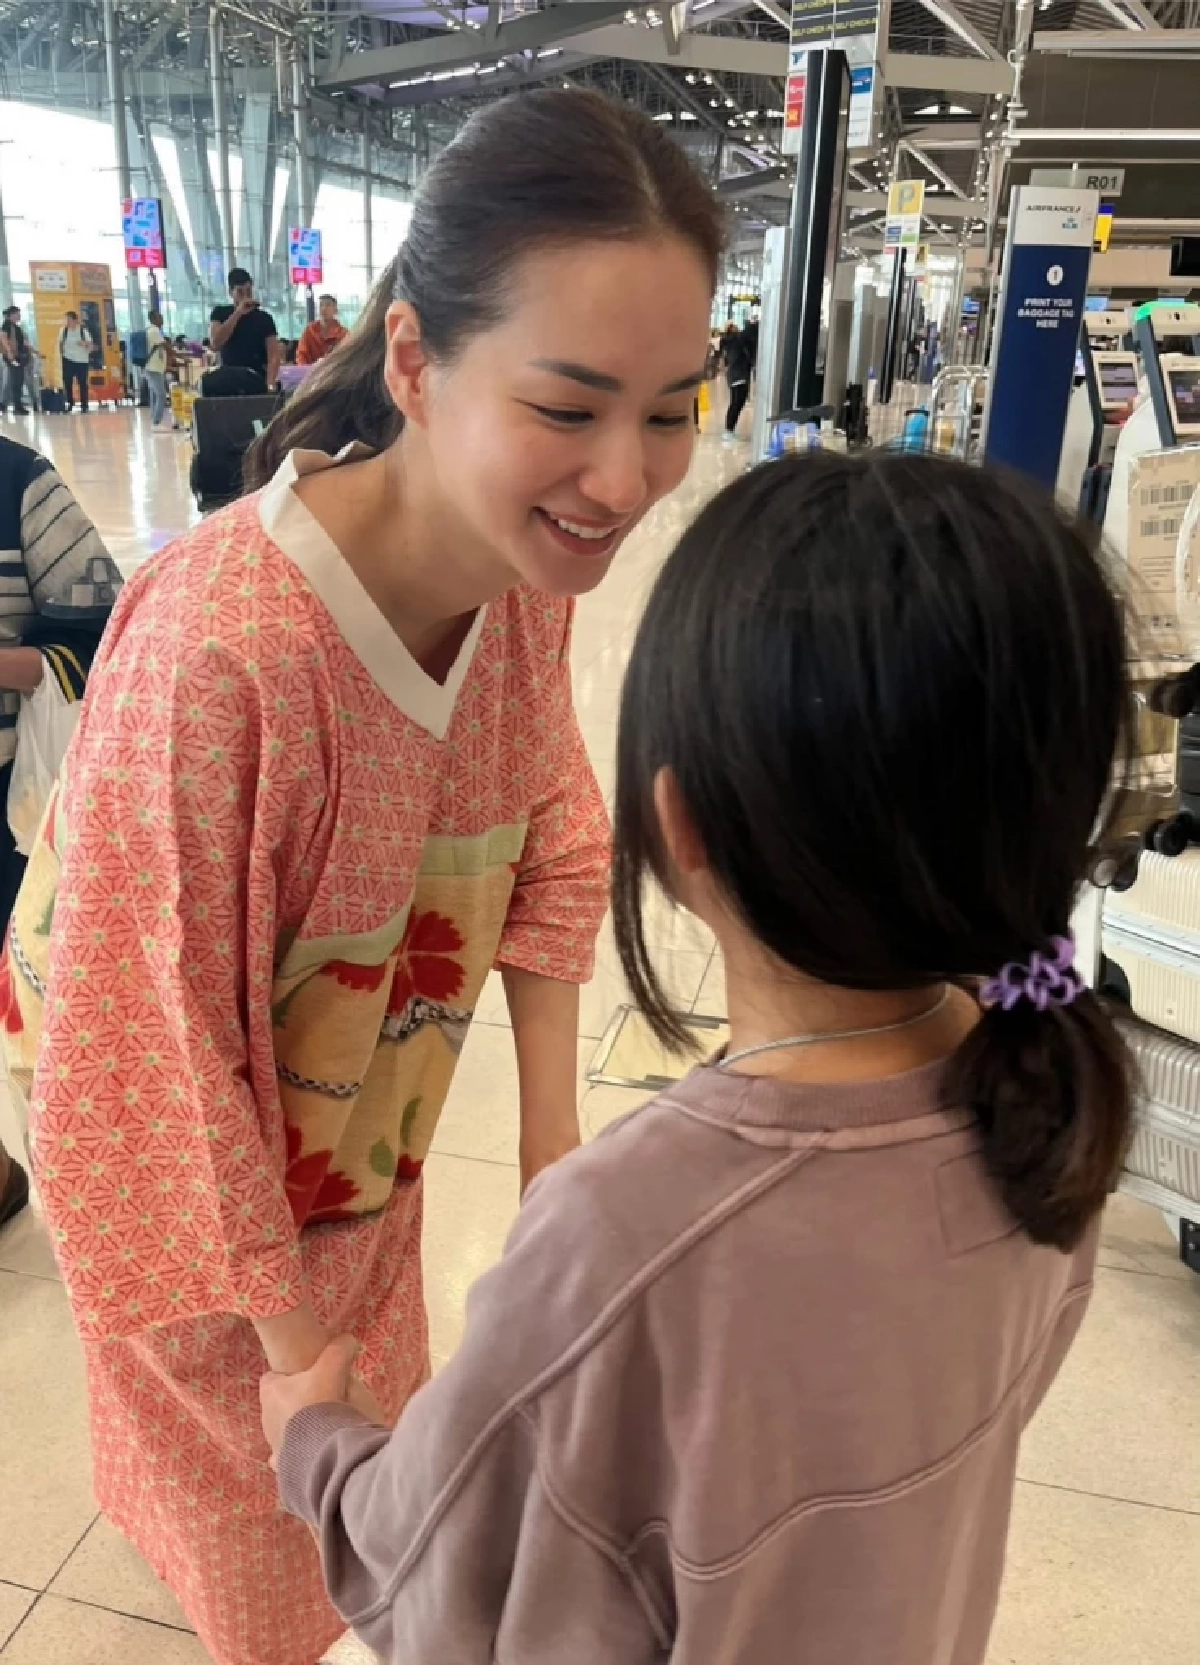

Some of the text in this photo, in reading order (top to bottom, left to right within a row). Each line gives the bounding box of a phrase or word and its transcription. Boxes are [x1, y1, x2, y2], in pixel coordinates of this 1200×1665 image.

[1087, 176, 1118, 190] R01
[1024, 298, 1073, 307] PRINT YOUR
[1017, 308, 1060, 318] BAGGAGE
[1036, 319, 1060, 328] HERE
